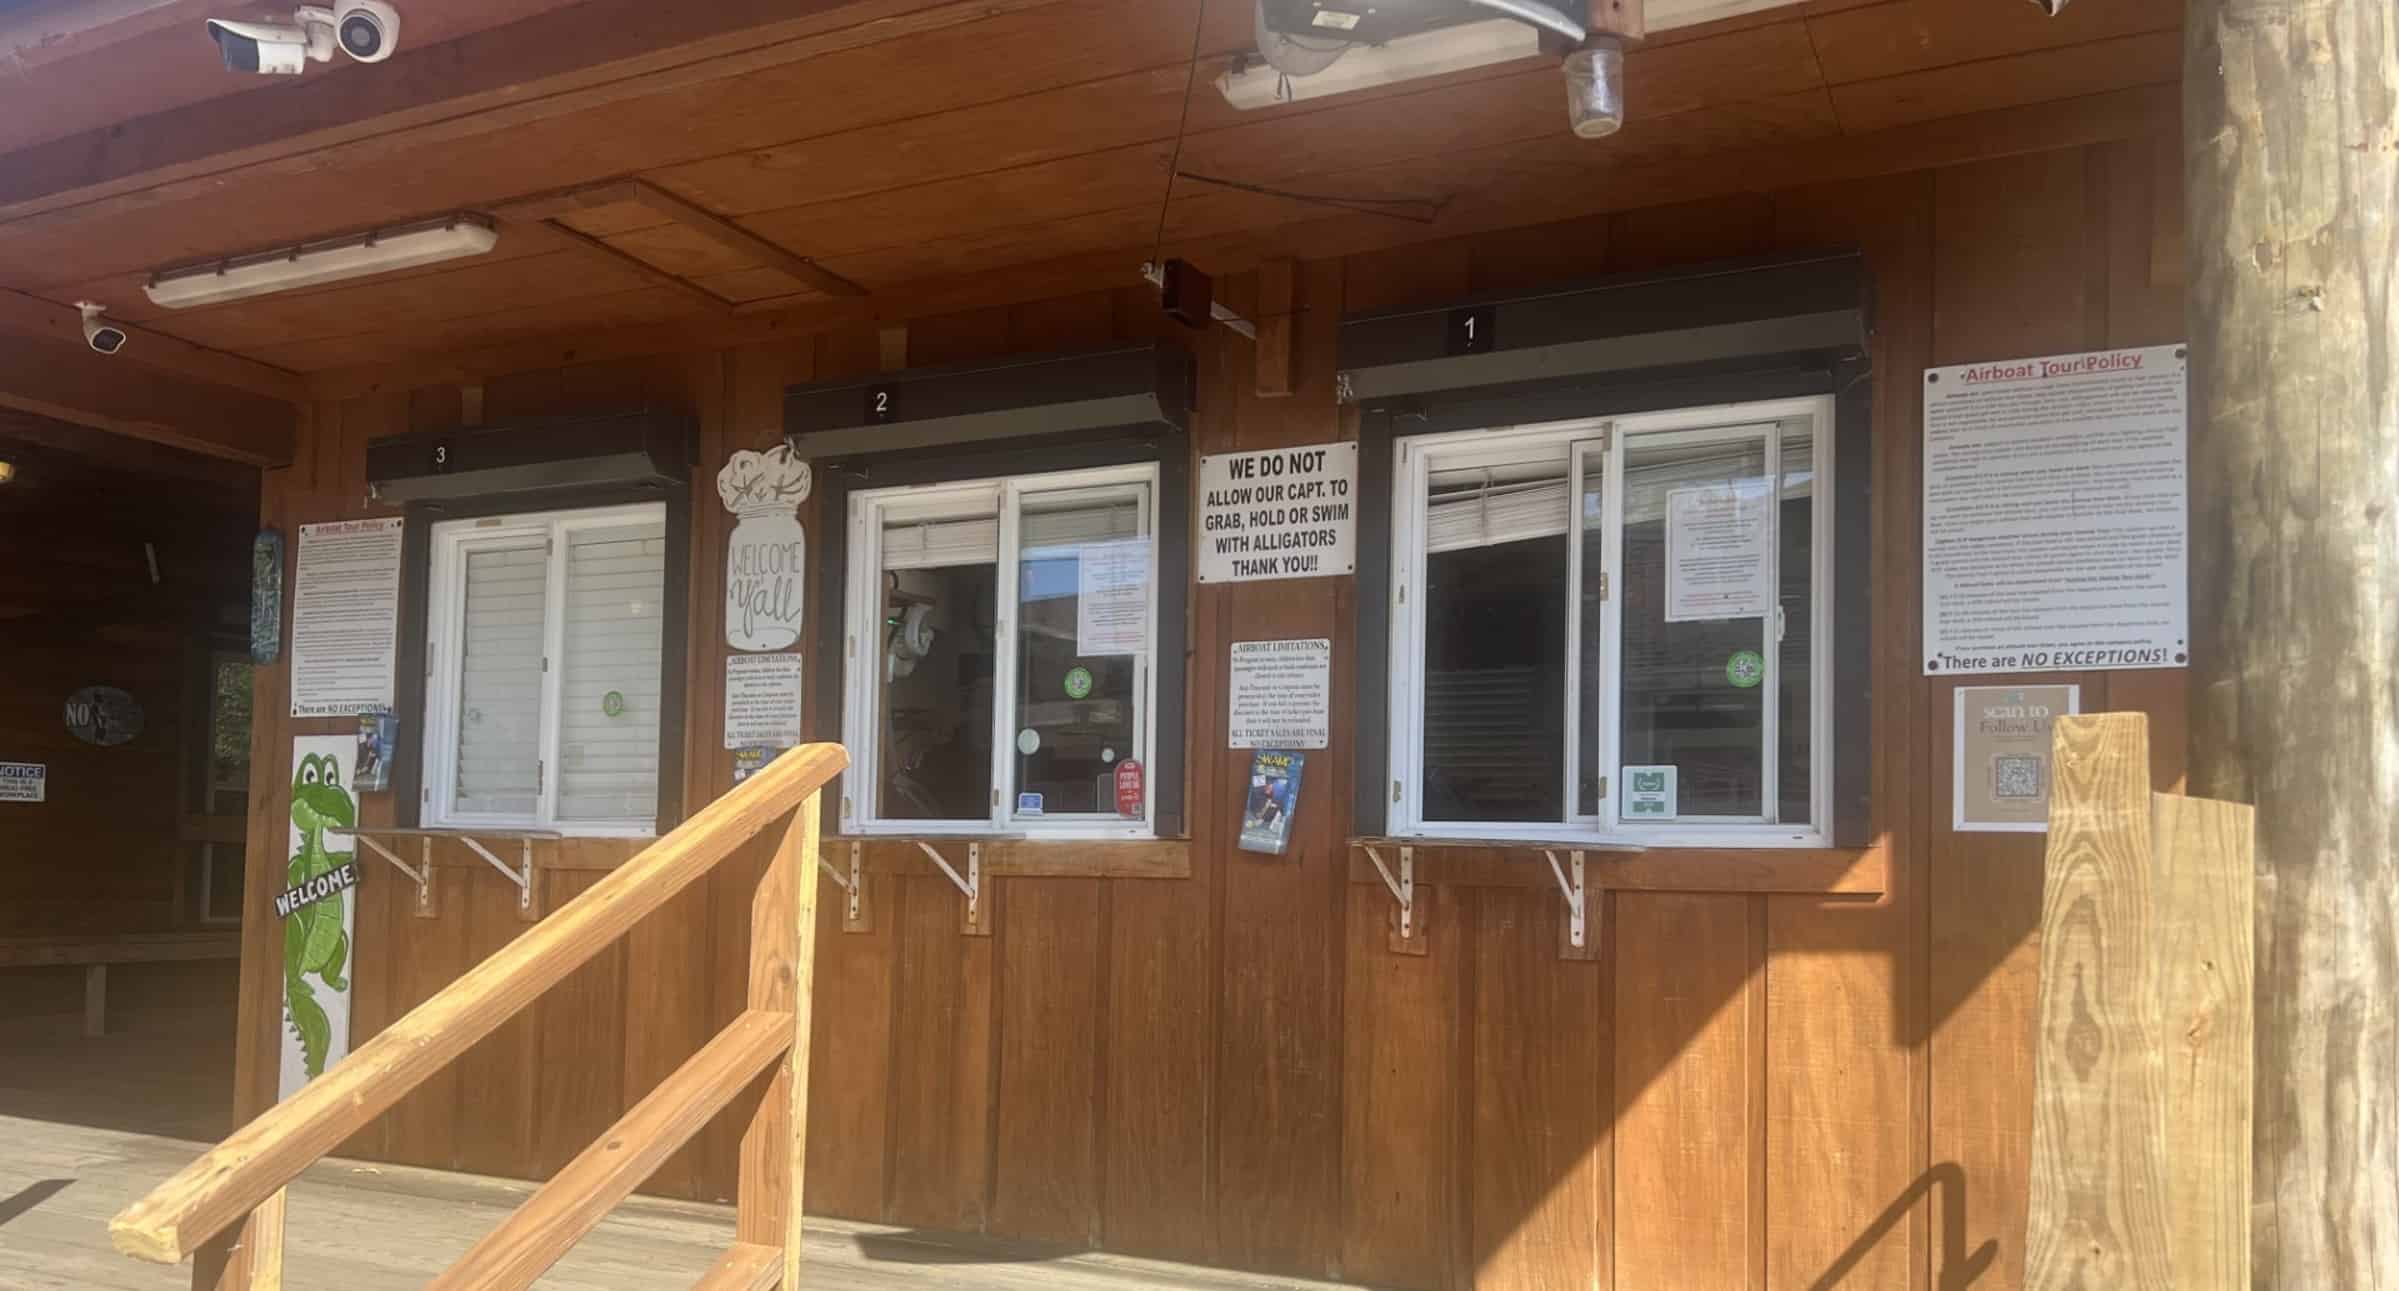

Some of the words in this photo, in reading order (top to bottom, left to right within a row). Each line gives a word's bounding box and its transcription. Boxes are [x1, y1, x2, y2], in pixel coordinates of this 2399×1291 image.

[1464, 316, 1475, 339] 1
[1965, 363, 2033, 383] Airboat
[2040, 360, 2081, 377] Tour
[2086, 353, 2143, 372] Policy
[876, 391, 887, 411] 2
[436, 446, 446, 463] 3
[1229, 458, 1255, 480] WE
[1260, 455, 1284, 477] DO
[1289, 450, 1326, 474] NOT
[1206, 488, 1252, 507] ALLOW
[1255, 485, 1284, 503] OUR
[1288, 481, 1326, 500] CAPT.
[1330, 479, 1348, 497] TO
[1205, 513, 1245, 532] GRAB,
[1250, 509, 1285, 528] HOLD
[1289, 507, 1308, 524] OR
[1312, 503, 1350, 523] SWIM
[1216, 536, 1249, 554] WITH
[1253, 529, 1337, 552] ALLIGATORS
[731, 542, 801, 576] WELCOME
[1232, 559, 1278, 577] THANK
[1282, 555, 1319, 573] YOU!!
[1943, 655, 1986, 669] There
[1991, 655, 2017, 667] are
[2021, 652, 2048, 667] NO
[2053, 647, 2168, 666] EXCEPTIONS!
[65, 703, 90, 726] NO
[327, 704, 337, 713] NO
[1978, 719, 2028, 735] Follow
[275, 864, 354, 917] WELCOME
